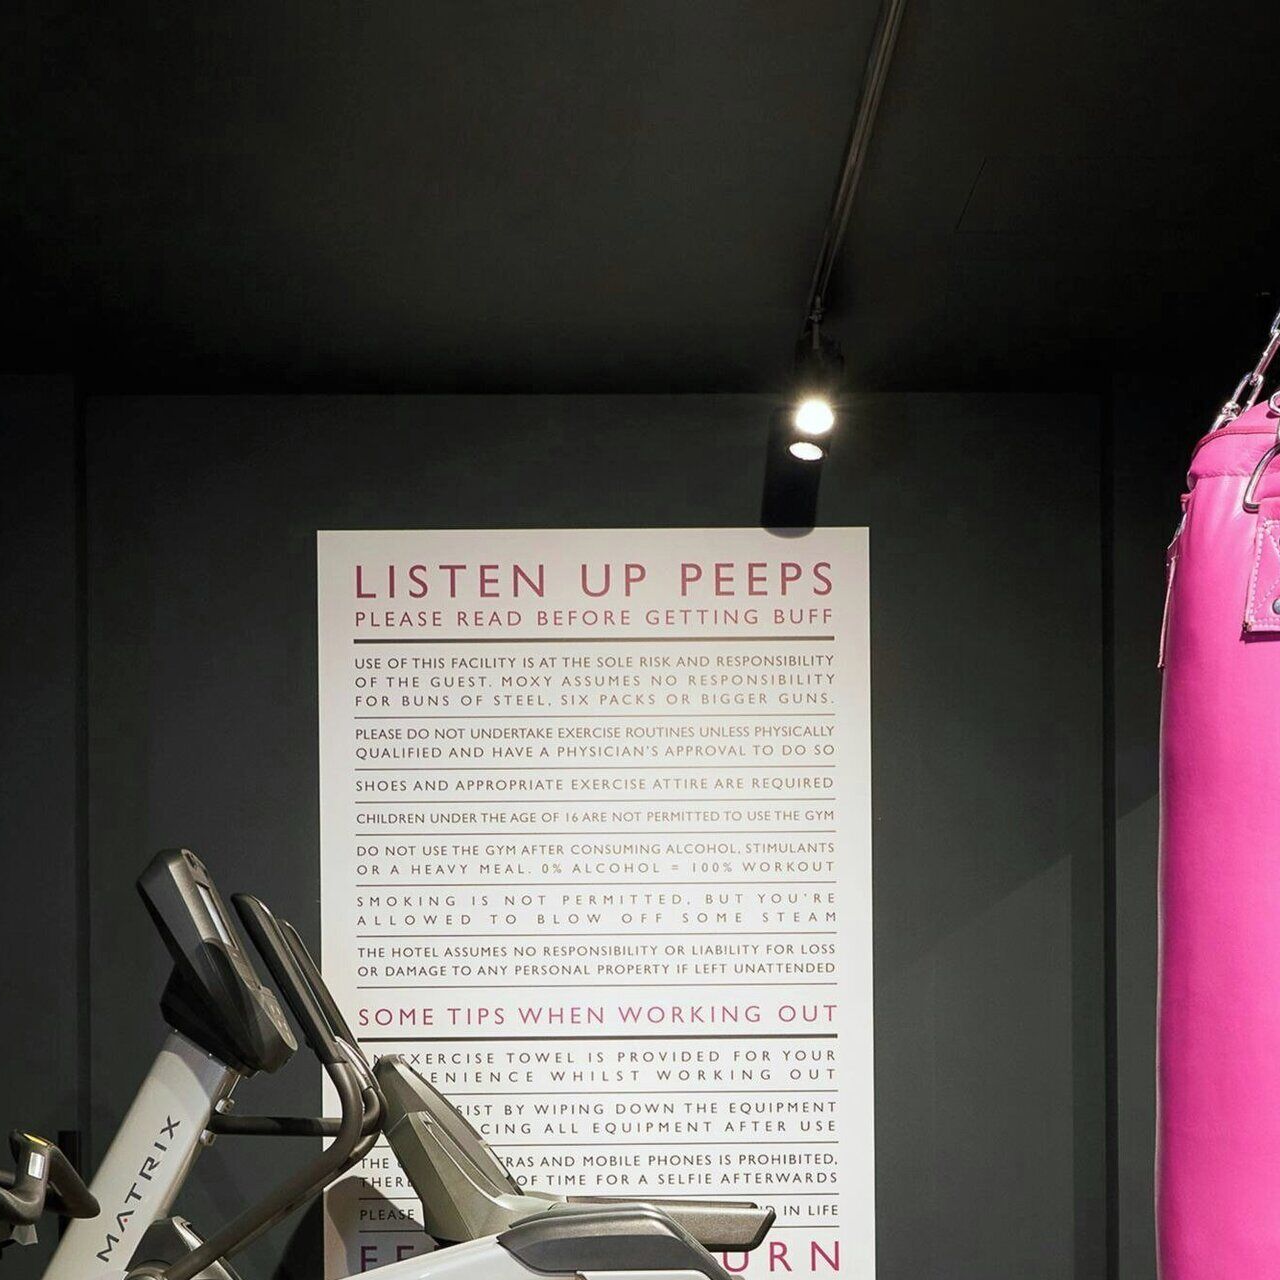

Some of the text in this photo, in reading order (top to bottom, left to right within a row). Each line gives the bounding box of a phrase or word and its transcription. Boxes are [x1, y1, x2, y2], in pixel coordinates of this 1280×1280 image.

[356, 562, 832, 598] LISTEN UP PEEPS
[355, 609, 832, 627] PLEASE READ BEFORE GETTING BUFF
[354, 654, 834, 670] USE OF THIS FACILITY IS AT THE SOLE RISK AND RESPONSIBILITY
[355, 692, 834, 707] FOR BUNS OF STEEL, SIX PACKS OR BIGGER GUNS.
[355, 726, 834, 740] PLEASE DO NOT UNDERTAKE EXERCISE ROUTINES UNLESS PHYSICALLY
[355, 777, 834, 791] SHOES AND APPROPRIATE EXERCISE ATTIRE ARE REQUIRED
[356, 843, 835, 857] DO NOT USE THE GYM AFTER CONSUMING ALCOHOL, STIMULANTS
[356, 912, 836, 926] ALLOWED TO BLOW OFF SOME STEAM
[357, 944, 835, 958] THE HOTEL ASSUMES NO RESPONSIBILITY OR LIABILITY FOR LOSS
[358, 1005, 837, 1026] SOME TIPS WHEN WORKING OUT
[506, 1052, 573, 1063] TOWEL
[588, 1052, 604, 1063] IS
[617, 1051, 720, 1063] PROVIDED
[733, 1051, 771, 1062] FOR
[782, 1050, 835, 1062] YOUR
[431, 1069, 835, 1083] ENIENCE WHILST WORKING OUT
[456, 1102, 836, 1116] SIST BY WIPING DOWN THE EQUIPMENT
[361, 1157, 389, 1169] THE
[540, 1156, 575, 1167] AND
[583, 1155, 640, 1167] MOBILE
[648, 1155, 712, 1165] PHONES
[719, 1155, 732, 1165] IS
[738, 1153, 838, 1165] PROHIBITED,
[516, 1175, 538, 1187] OF
[546, 1174, 585, 1185] TIME
[596, 1174, 629, 1185] FOR
[638, 1175, 648, 1185] A
[658, 1173, 712, 1185] SELFIE
[720, 1172, 837, 1184] AFTERWARDS
[96, 1115, 181, 1263] MATRIX
[360, 1209, 414, 1221] PLEASE
[783, 1206, 800, 1216] IN
[808, 1205, 838, 1216] LIFE
[723, 1241, 840, 1273] URN
